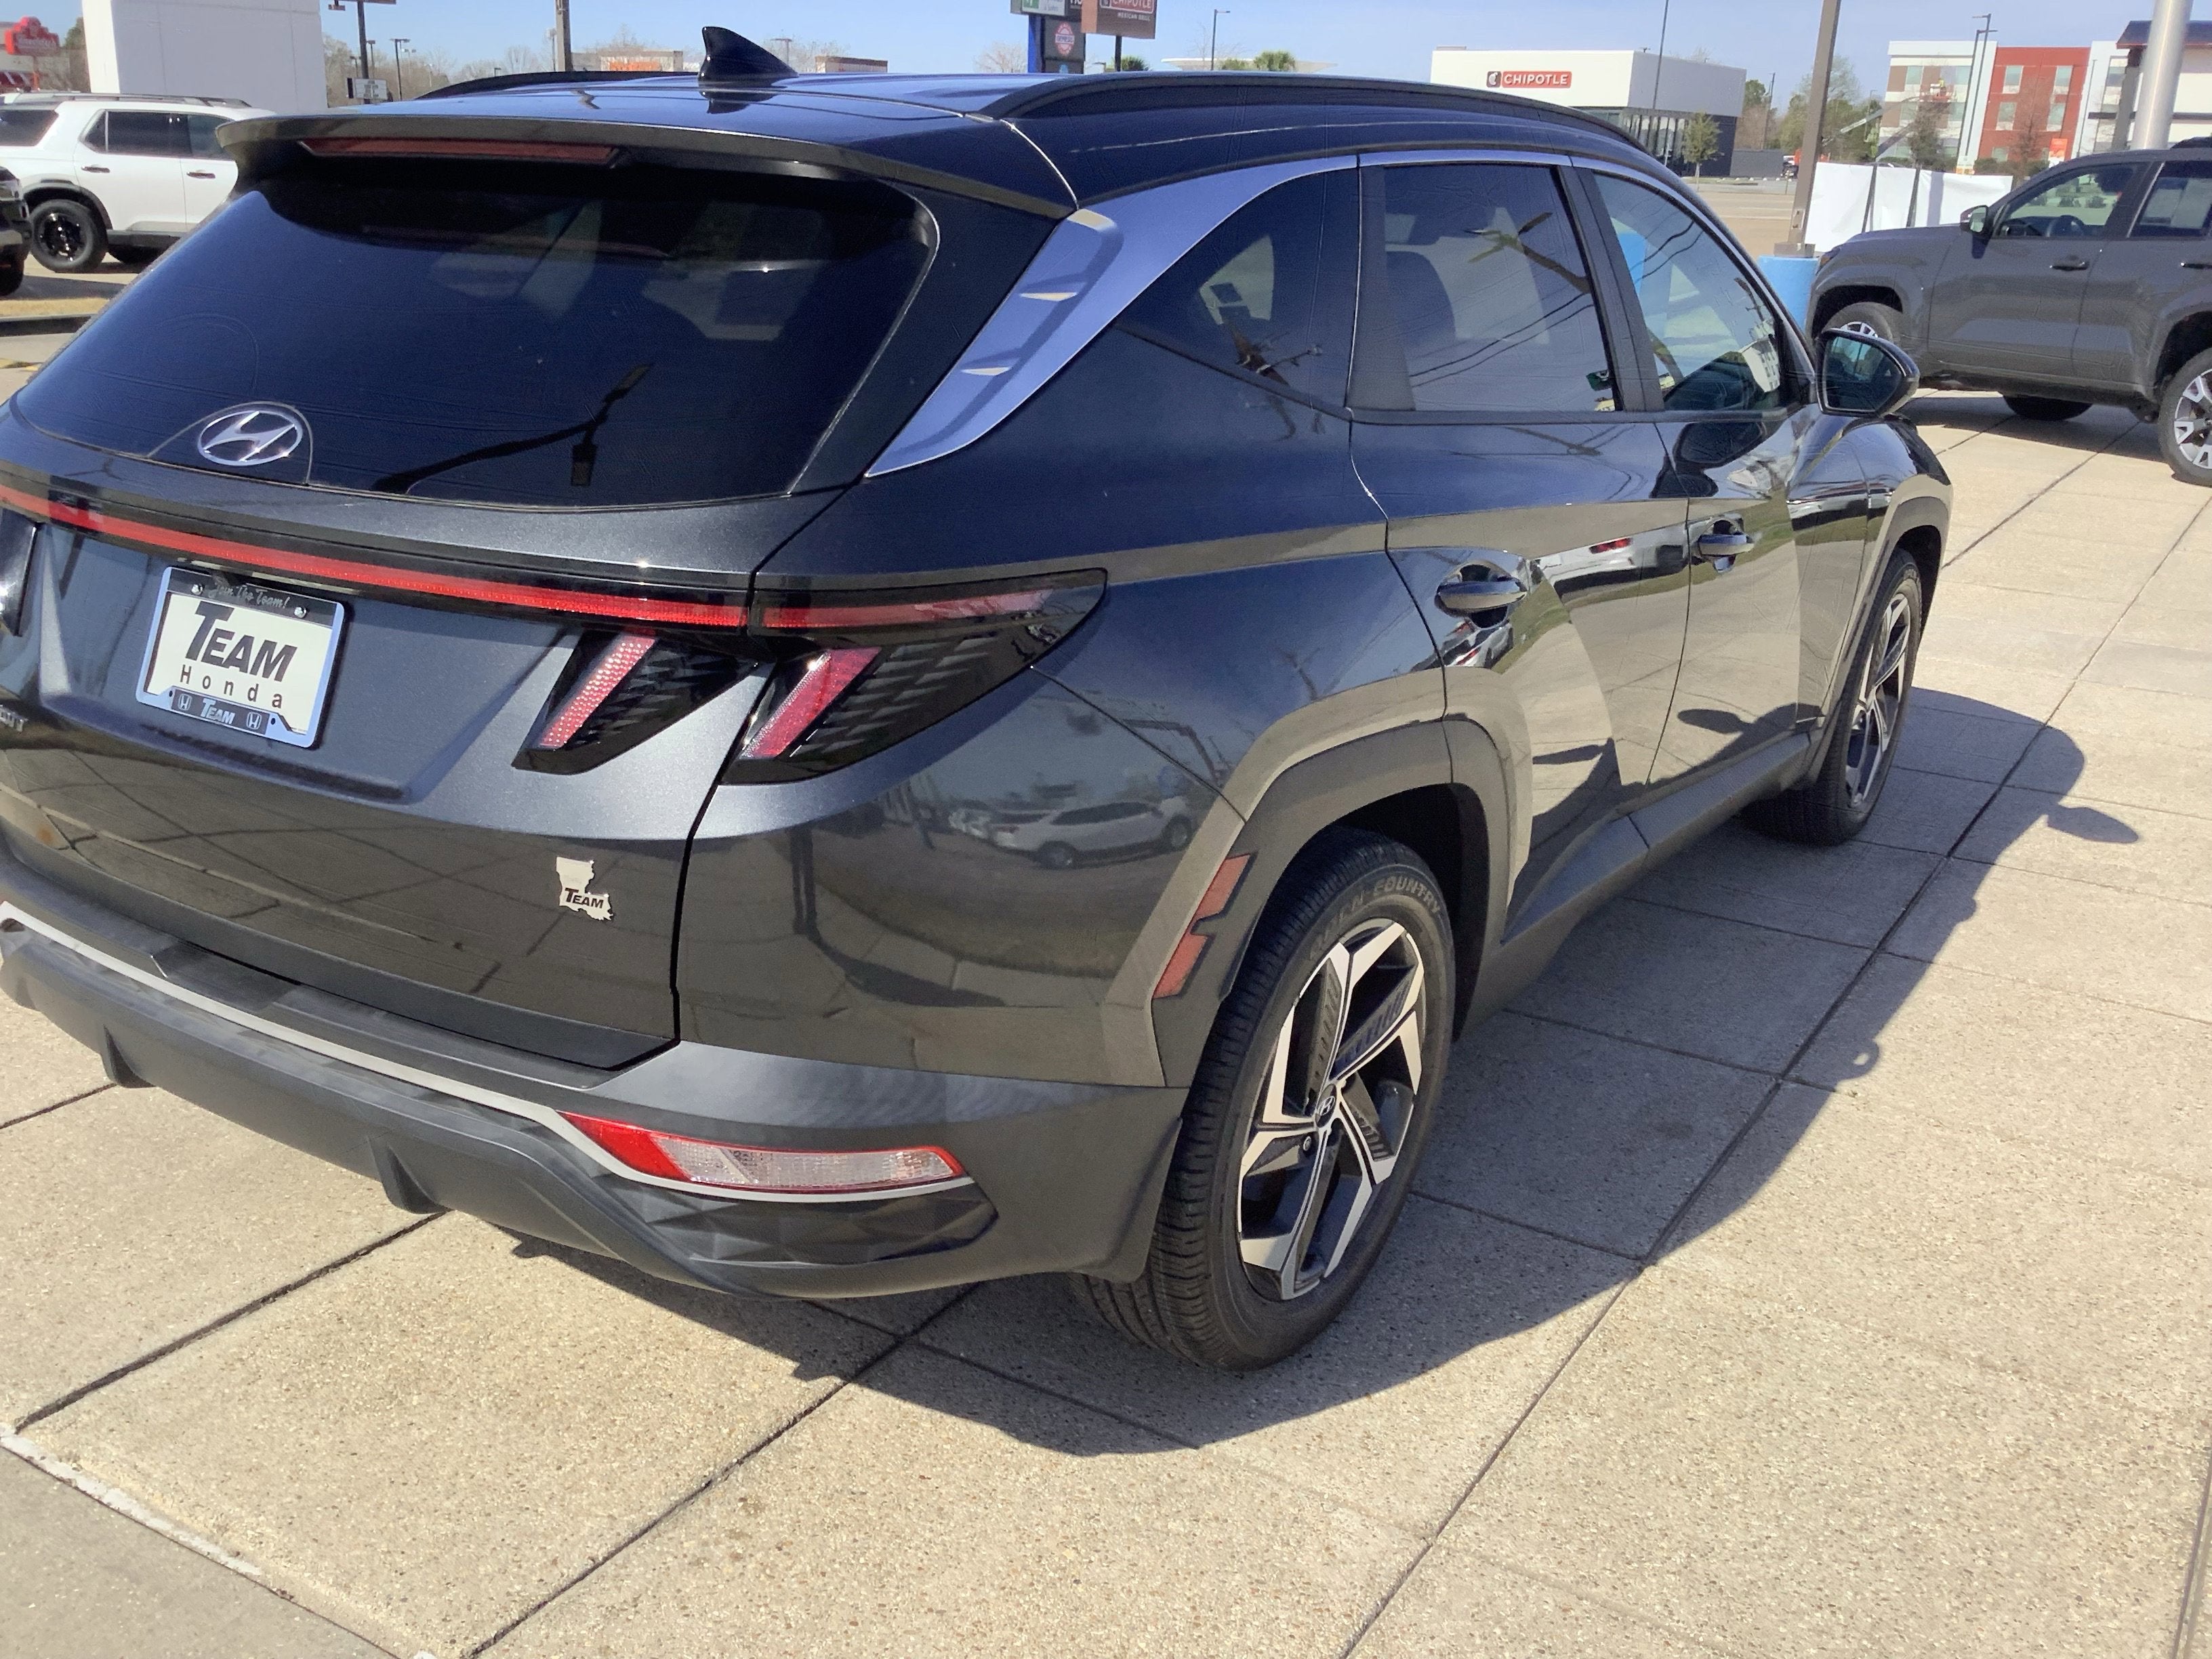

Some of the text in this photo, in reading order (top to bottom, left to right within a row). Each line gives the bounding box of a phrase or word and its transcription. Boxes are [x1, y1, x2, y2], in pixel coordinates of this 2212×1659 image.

[1503, 73, 1568, 85] CHIPOTLE
[236, 584, 254, 601] The
[255, 588, 291, 609] Team!
[185, 600, 298, 682] TEAM
[180, 664, 283, 709] Honda
[200, 697, 236, 725] TEAM
[565, 887, 604, 909] TEAM
